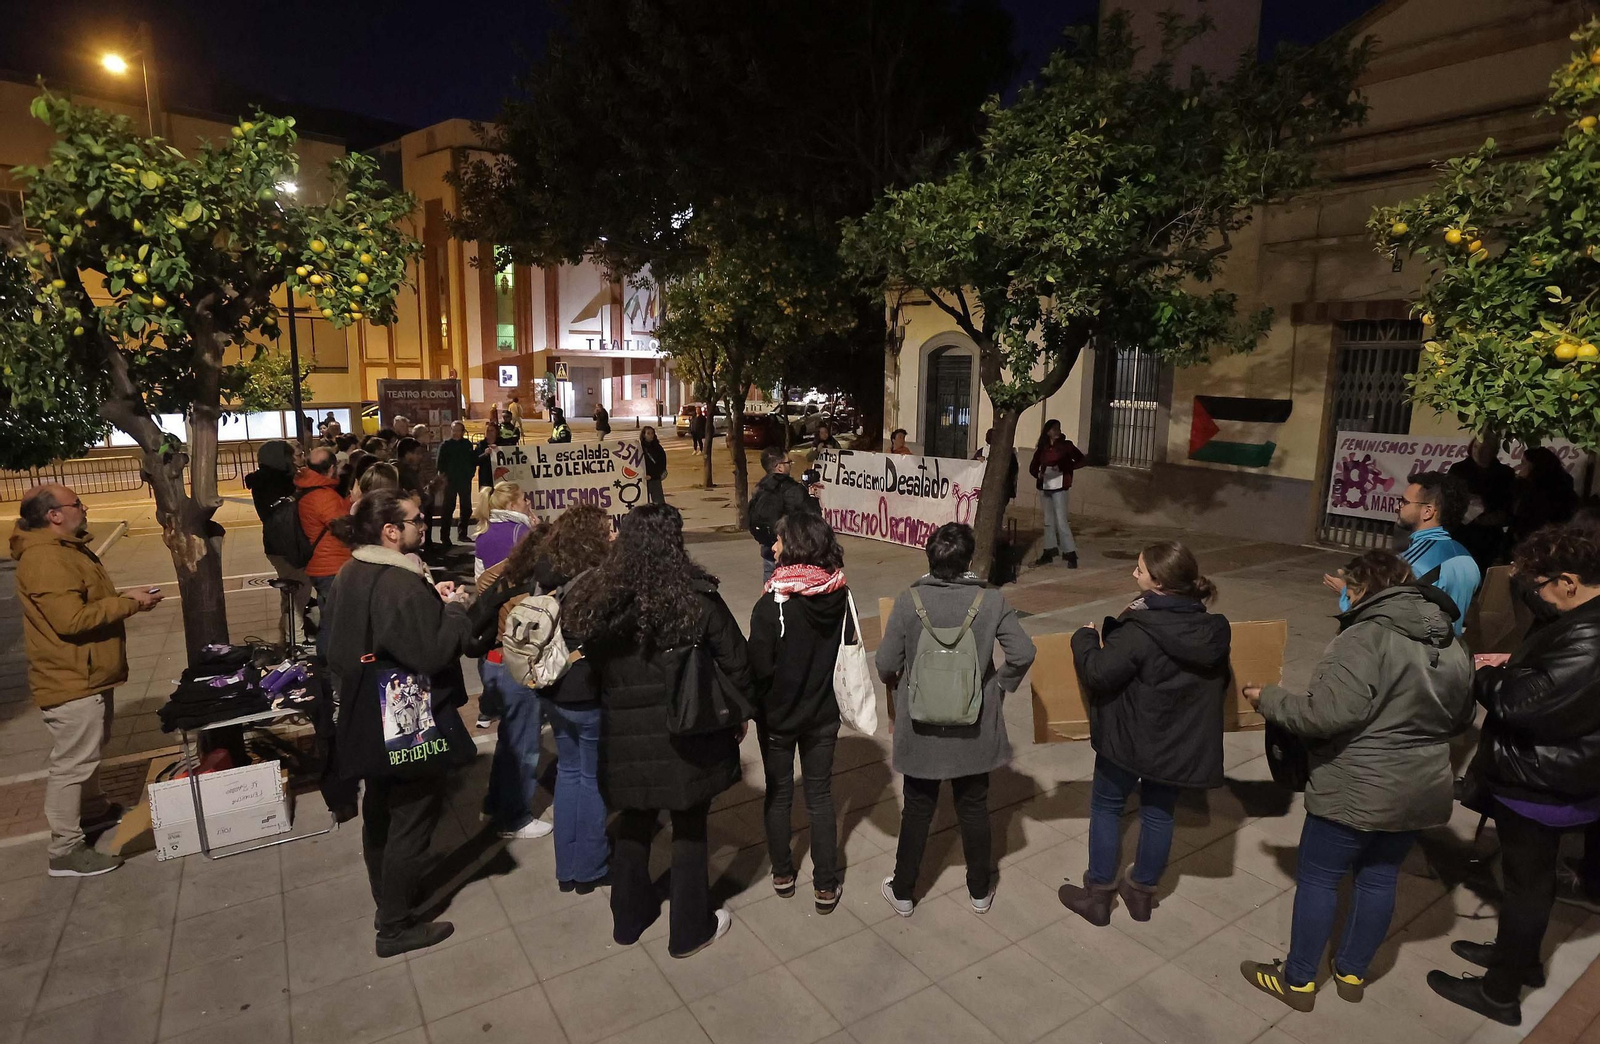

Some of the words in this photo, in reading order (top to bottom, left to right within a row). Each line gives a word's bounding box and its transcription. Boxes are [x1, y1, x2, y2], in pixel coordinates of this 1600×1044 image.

[386, 390, 420, 399] TEATRO
[421, 390, 455, 399] FLORIDA
[497, 447, 528, 466] Ante
[537, 446, 547, 464] la
[555, 444, 610, 463] escalada
[612, 440, 645, 468] 25N
[815, 449, 837, 463] ntra
[1340, 438, 1419, 456] FEMINISMOS
[1422, 442, 1469, 459] DIVER
[531, 459, 615, 479] VIOLENCIA
[835, 450, 885, 493] Fascismo
[885, 456, 949, 499] Desatado
[524, 486, 612, 511] MINISMOS
[822, 507, 878, 536] MINISMO
[388, 738, 450, 766] BEETLEJUICE
